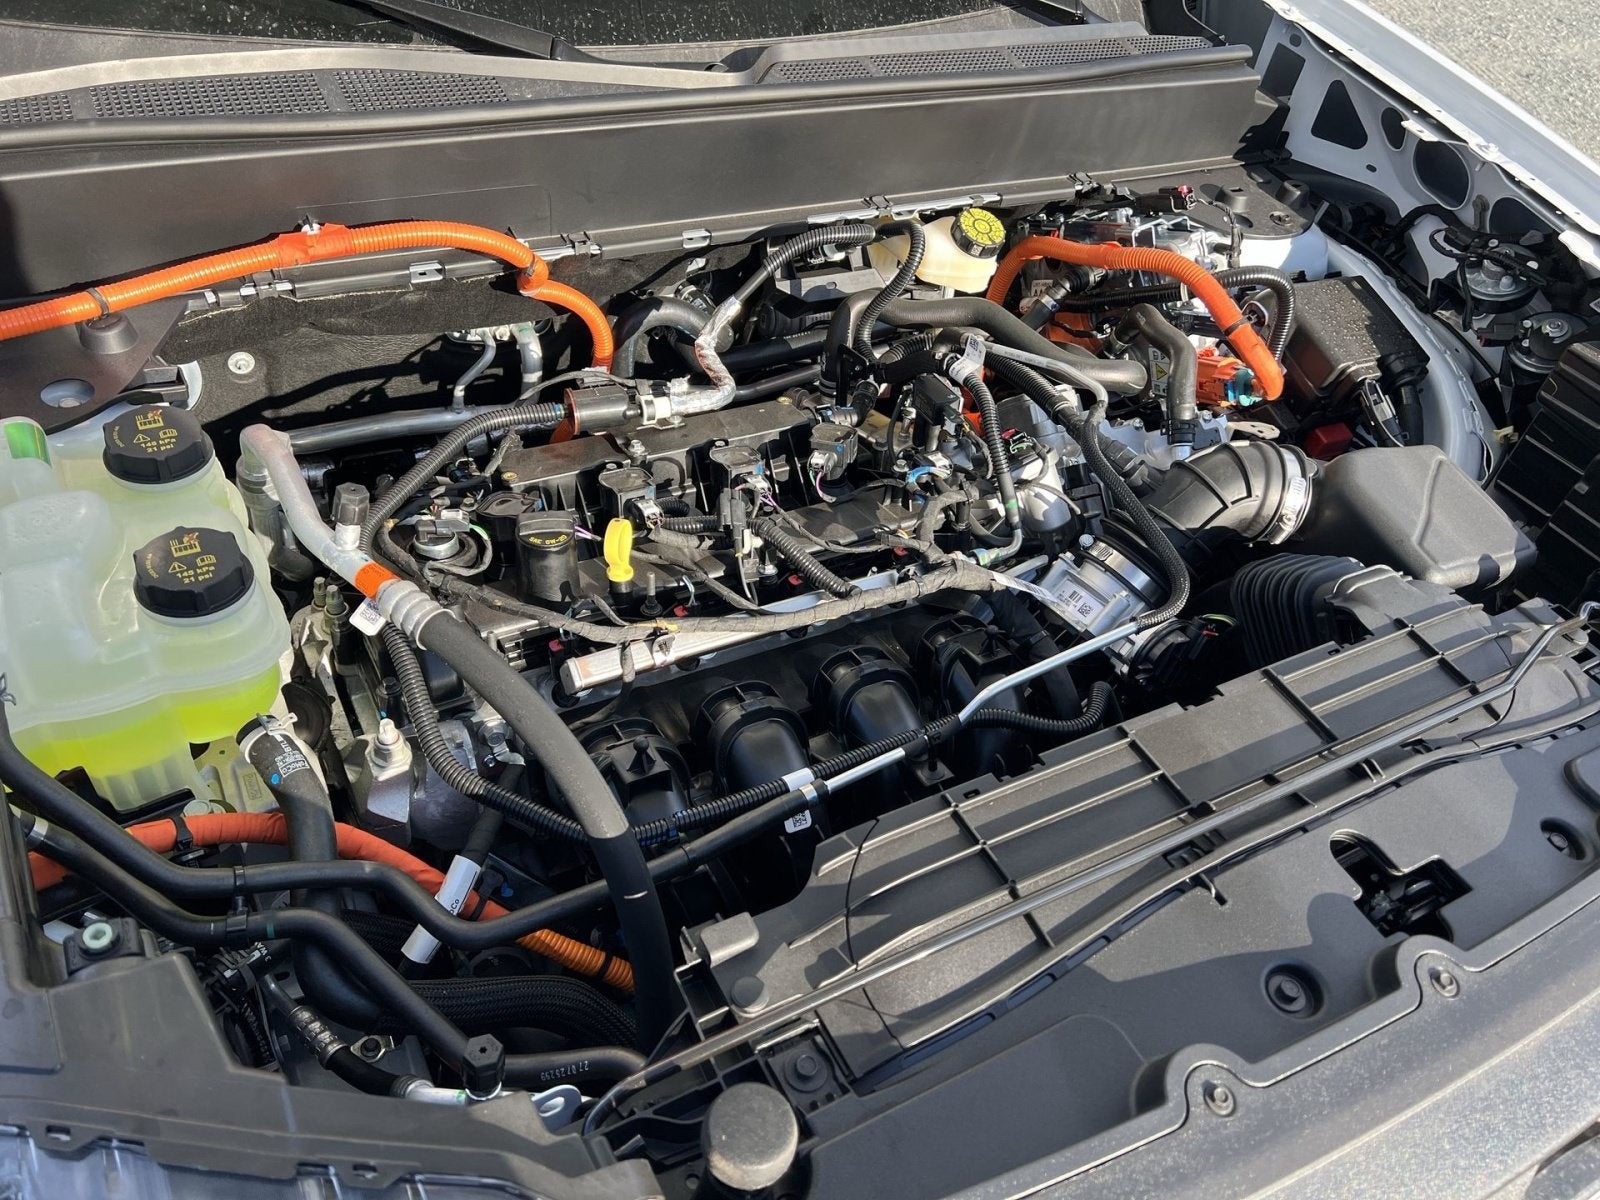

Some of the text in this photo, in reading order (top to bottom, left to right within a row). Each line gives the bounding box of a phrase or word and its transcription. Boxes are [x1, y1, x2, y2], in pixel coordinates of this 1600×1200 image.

[529, 536, 542, 545] SAE
[176, 566, 216, 579] 145 kPa
[183, 572, 213, 584] 21 psi
